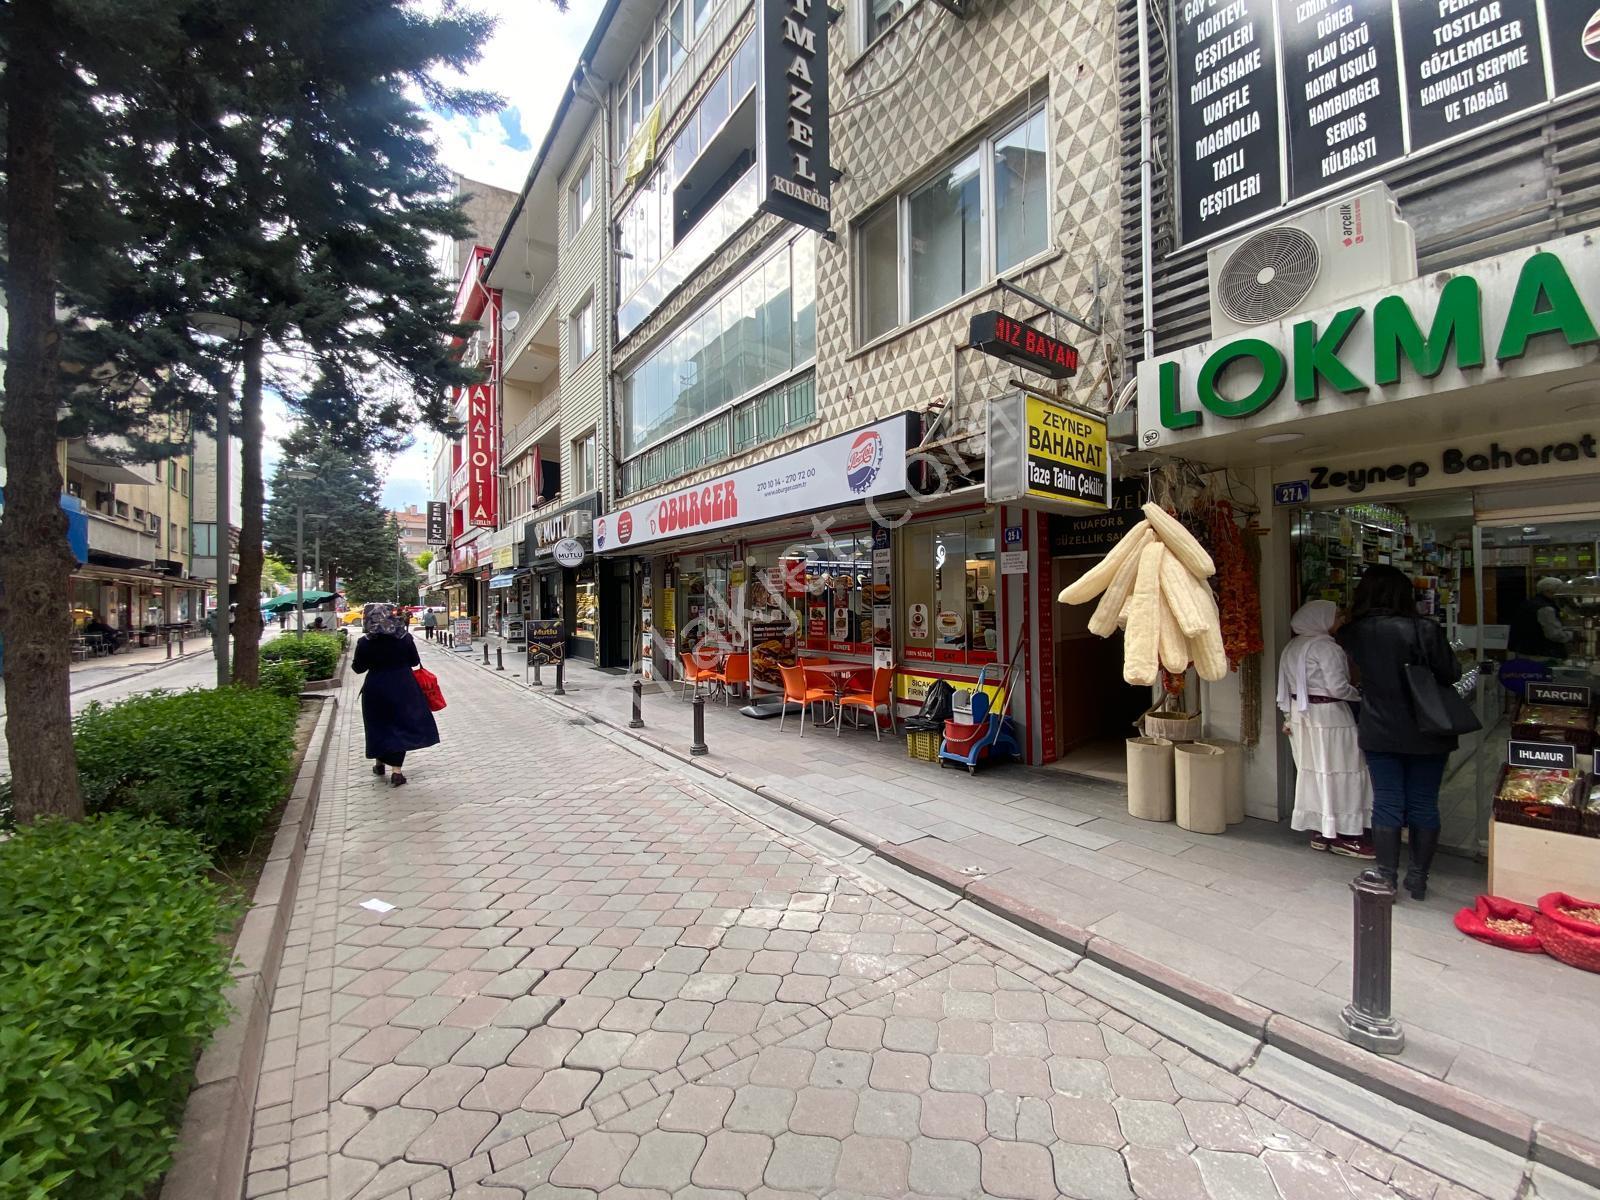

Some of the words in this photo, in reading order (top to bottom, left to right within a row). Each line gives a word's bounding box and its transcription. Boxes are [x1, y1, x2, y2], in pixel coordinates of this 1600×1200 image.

[1197, 0, 1248, 43] KOKTEYL
[1317, 5, 1353, 39] DÖNER
[1433, 1, 1501, 46] TOSTLAR
[1307, 41, 1337, 72] PİLAV
[1340, 21, 1369, 55] ÜSTÜ
[1420, 20, 1522, 79] GÖZLEMELER
[1305, 68, 1337, 101] HATAY
[1340, 46, 1377, 83] USULÜ
[1420, 68, 1474, 107] KAHVALTI
[1476, 45, 1529, 83] SERPME
[1203, 85, 1250, 126] WAFFLE
[1308, 77, 1380, 127] HAMBURGER
[1444, 103, 1461, 123] VE
[1464, 81, 1509, 116] TABAĞI
[1326, 112, 1367, 146] SERVİS
[1212, 148, 1244, 182] TATLI
[1321, 137, 1377, 177] KÜLBASTI
[774, 175, 830, 211] KUAFÖR
[1200, 173, 1261, 221] ÇEŞİTLERİ
[1340, 204, 1354, 236] arçelik
[1025, 330, 1077, 370] BAYAN
[1159, 252, 1600, 430] LOKMA
[1043, 409, 1092, 438] ZEYNEP
[1029, 426, 1103, 467] BAHARAT
[1310, 460, 1429, 493] Zeynep
[1443, 434, 1597, 475] Baharat
[757, 482, 767, 492] 270
[785, 473, 797, 484] 270
[807, 467, 816, 478] 00
[1029, 461, 1051, 485] Taze
[1053, 467, 1076, 491] Tahin
[1078, 473, 1104, 497] Çekilir
[658, 480, 736, 534] OBURGER
[907, 687, 923, 696] FIRIN
[1536, 689, 1582, 701] TARÇIN
[1520, 749, 1564, 762] IHLAMUR
